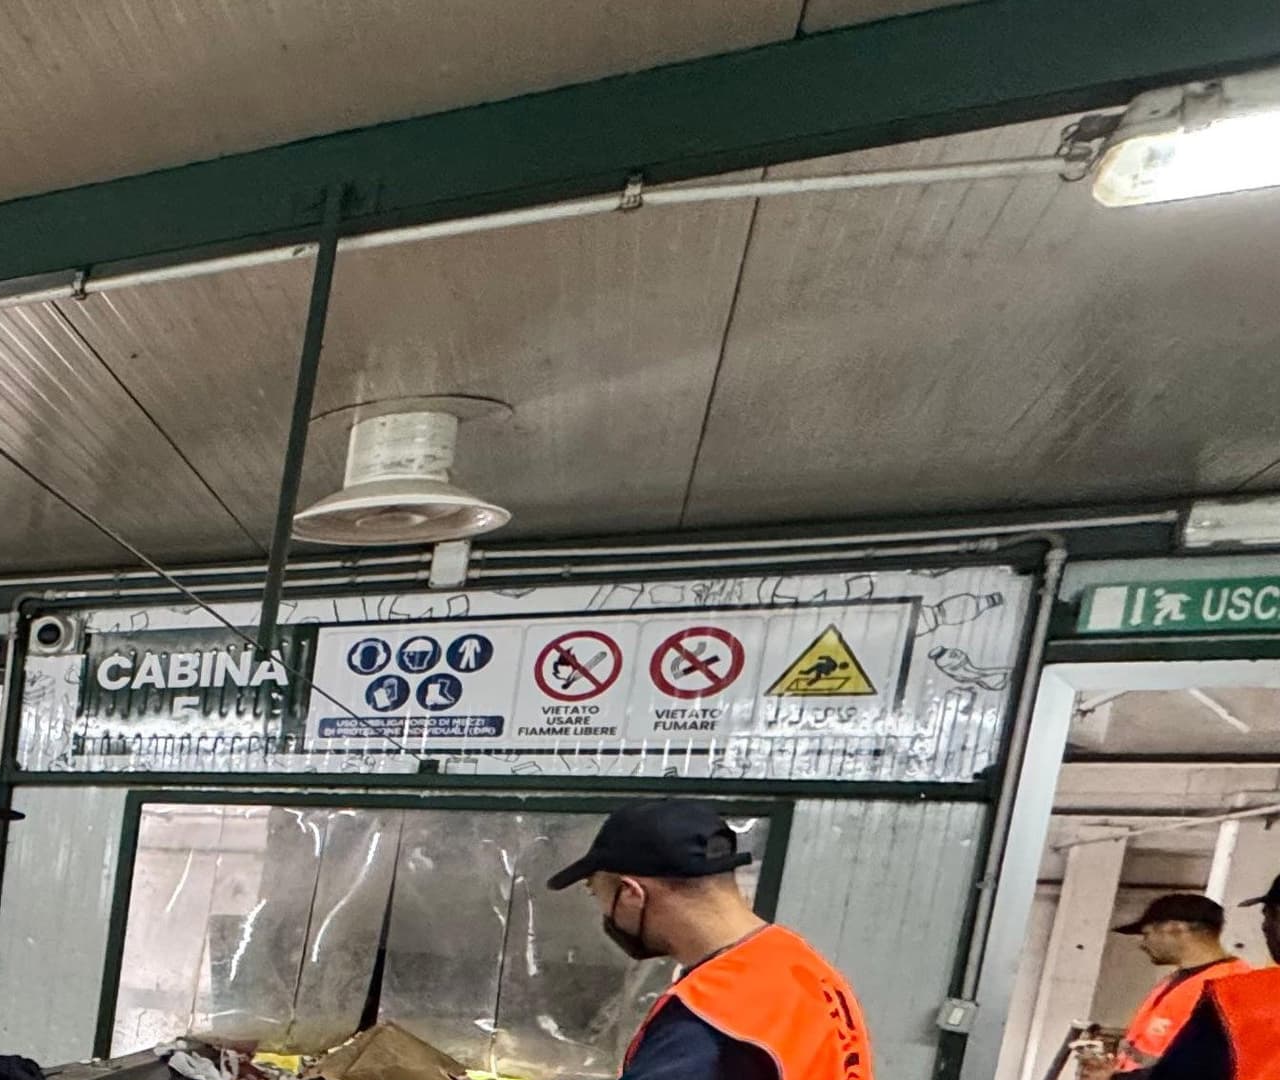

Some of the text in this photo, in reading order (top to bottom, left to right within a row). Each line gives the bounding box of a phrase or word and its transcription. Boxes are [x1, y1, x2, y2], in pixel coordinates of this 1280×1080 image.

[1202, 585, 1280, 621] USC
[97, 650, 289, 690] CABINA
[541, 706, 599, 715] VIETATO
[655, 708, 722, 719] VIETATO
[546, 716, 591, 725] USARE
[653, 720, 720, 731] FUMARE
[518, 726, 617, 736] FIAMME LIBERE
